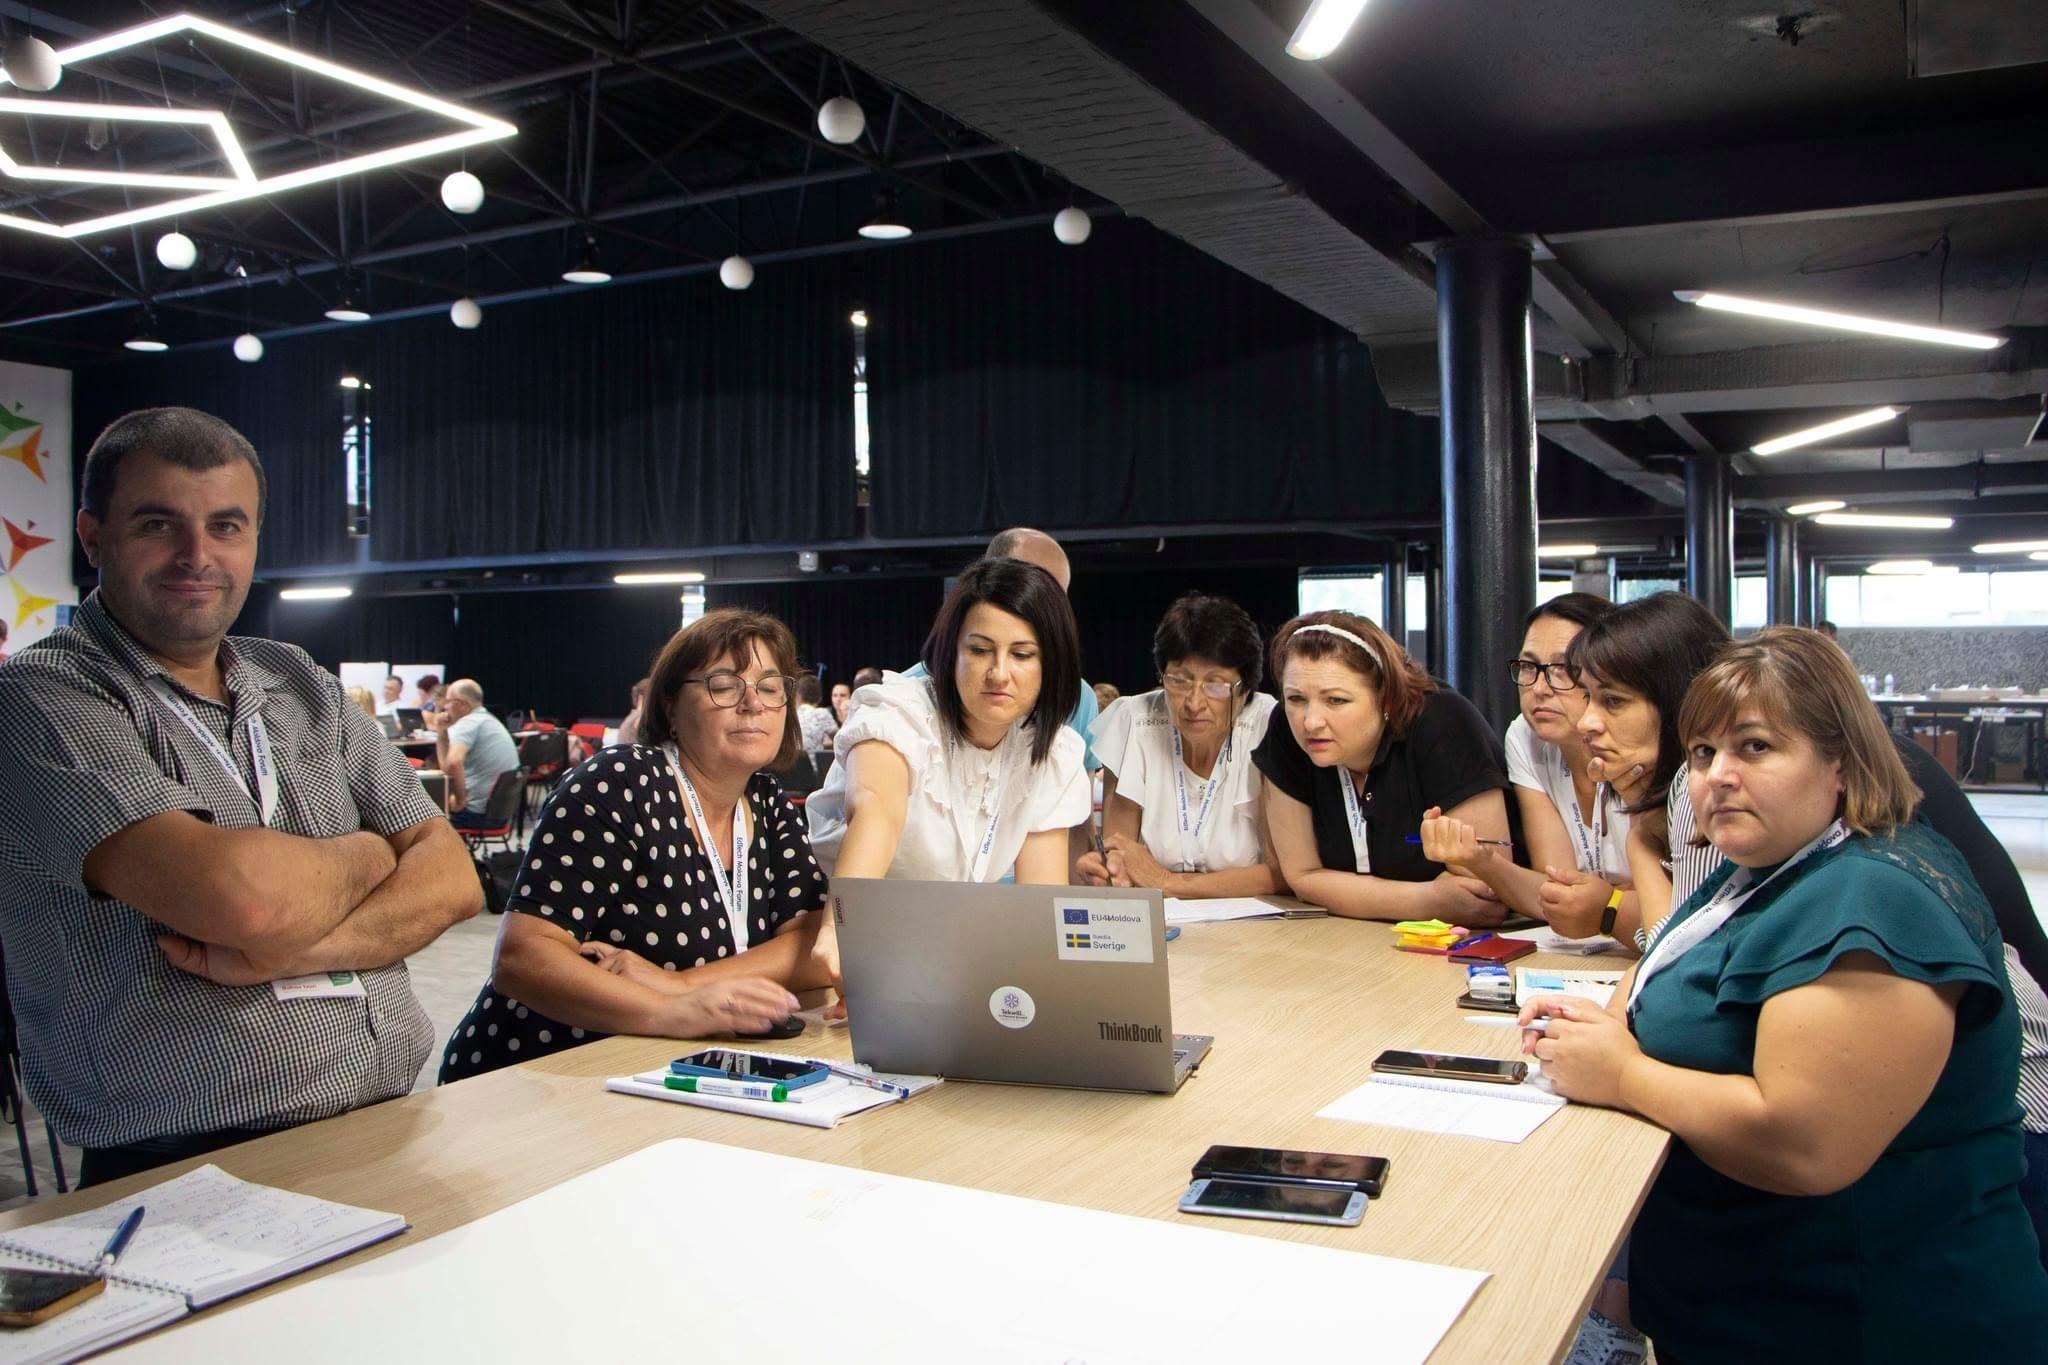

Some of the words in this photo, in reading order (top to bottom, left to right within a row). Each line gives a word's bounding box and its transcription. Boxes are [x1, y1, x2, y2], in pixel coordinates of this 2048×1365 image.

[167, 694, 189, 718] Forum
[187, 716, 216, 748] Moldova
[252, 726, 262, 755] Moldova
[258, 755, 269, 776] Forum
[1571, 802, 1581, 823] Forum
[736, 837, 744, 859] EdTech
[736, 861, 744, 888] Moldova
[736, 888, 744, 912] Forum
[1711, 883, 1736, 906] EdTech
[1091, 913, 1142, 923] EU4Moldova
[1093, 941, 1126, 952] Sverige
[1097, 1022, 1163, 1043] ThinkBook
